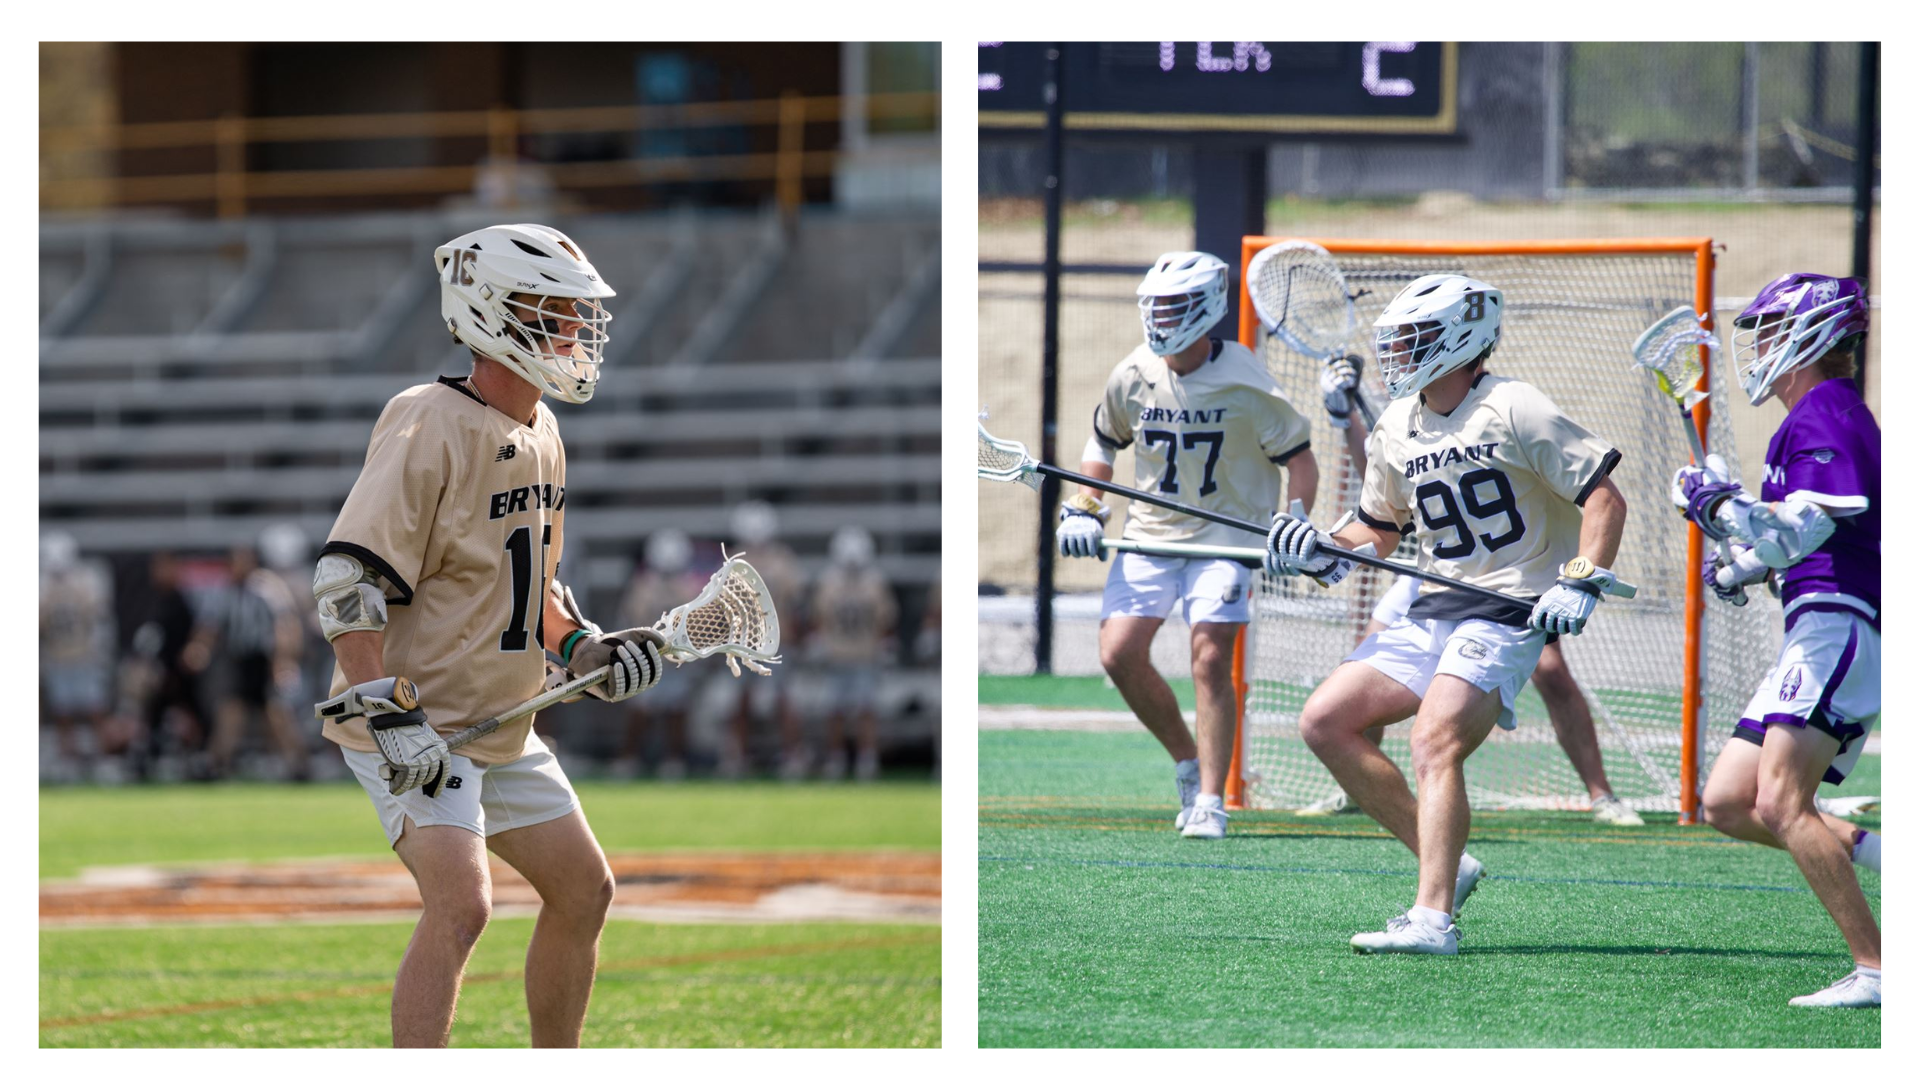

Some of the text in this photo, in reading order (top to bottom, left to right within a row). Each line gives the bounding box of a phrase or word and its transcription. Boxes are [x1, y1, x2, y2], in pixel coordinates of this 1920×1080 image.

[1141, 406, 1227, 424] BRYANT
[1143, 429, 1225, 498] 77
[1404, 442, 1499, 479] BRYANT
[488, 483, 565, 521] BRYAT
[1415, 467, 1527, 560] 99
